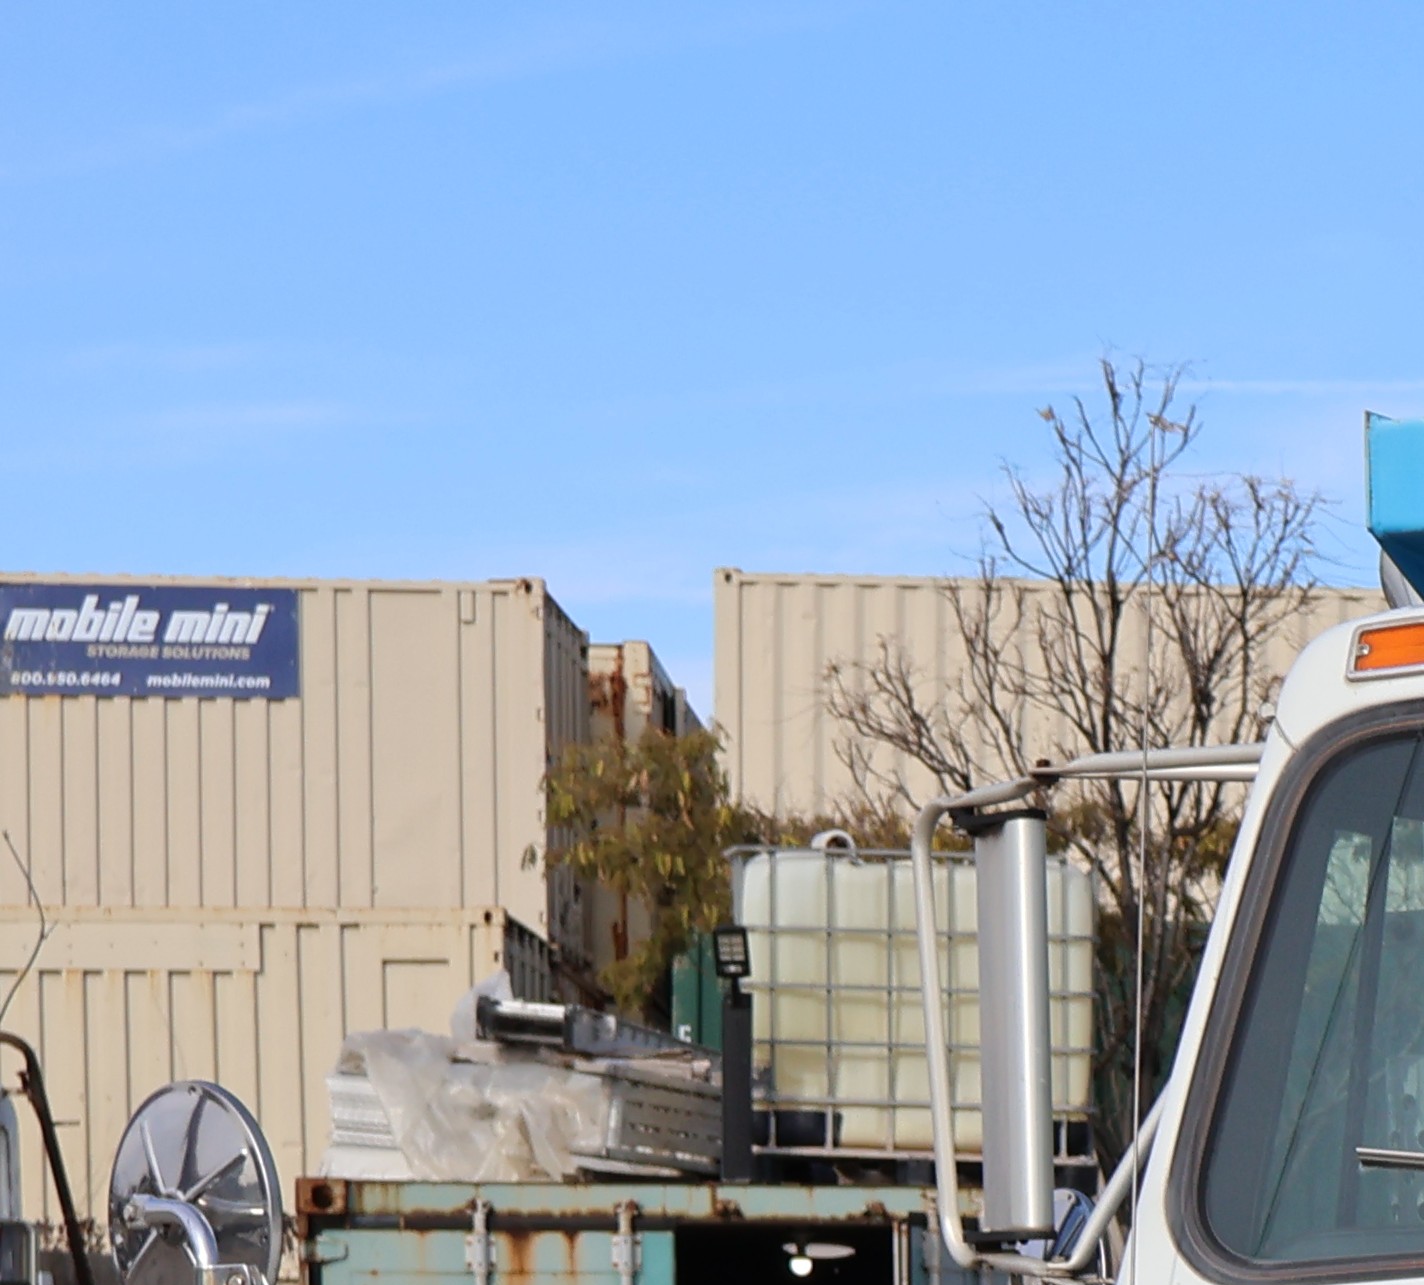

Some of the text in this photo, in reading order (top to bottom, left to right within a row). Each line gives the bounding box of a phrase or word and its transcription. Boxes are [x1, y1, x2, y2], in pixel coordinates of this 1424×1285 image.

[4, 594, 270, 644] mobile mini
[86, 645, 250, 661] STORAGE SOLUTIONS
[146, 672, 271, 689] mobilemini.com
